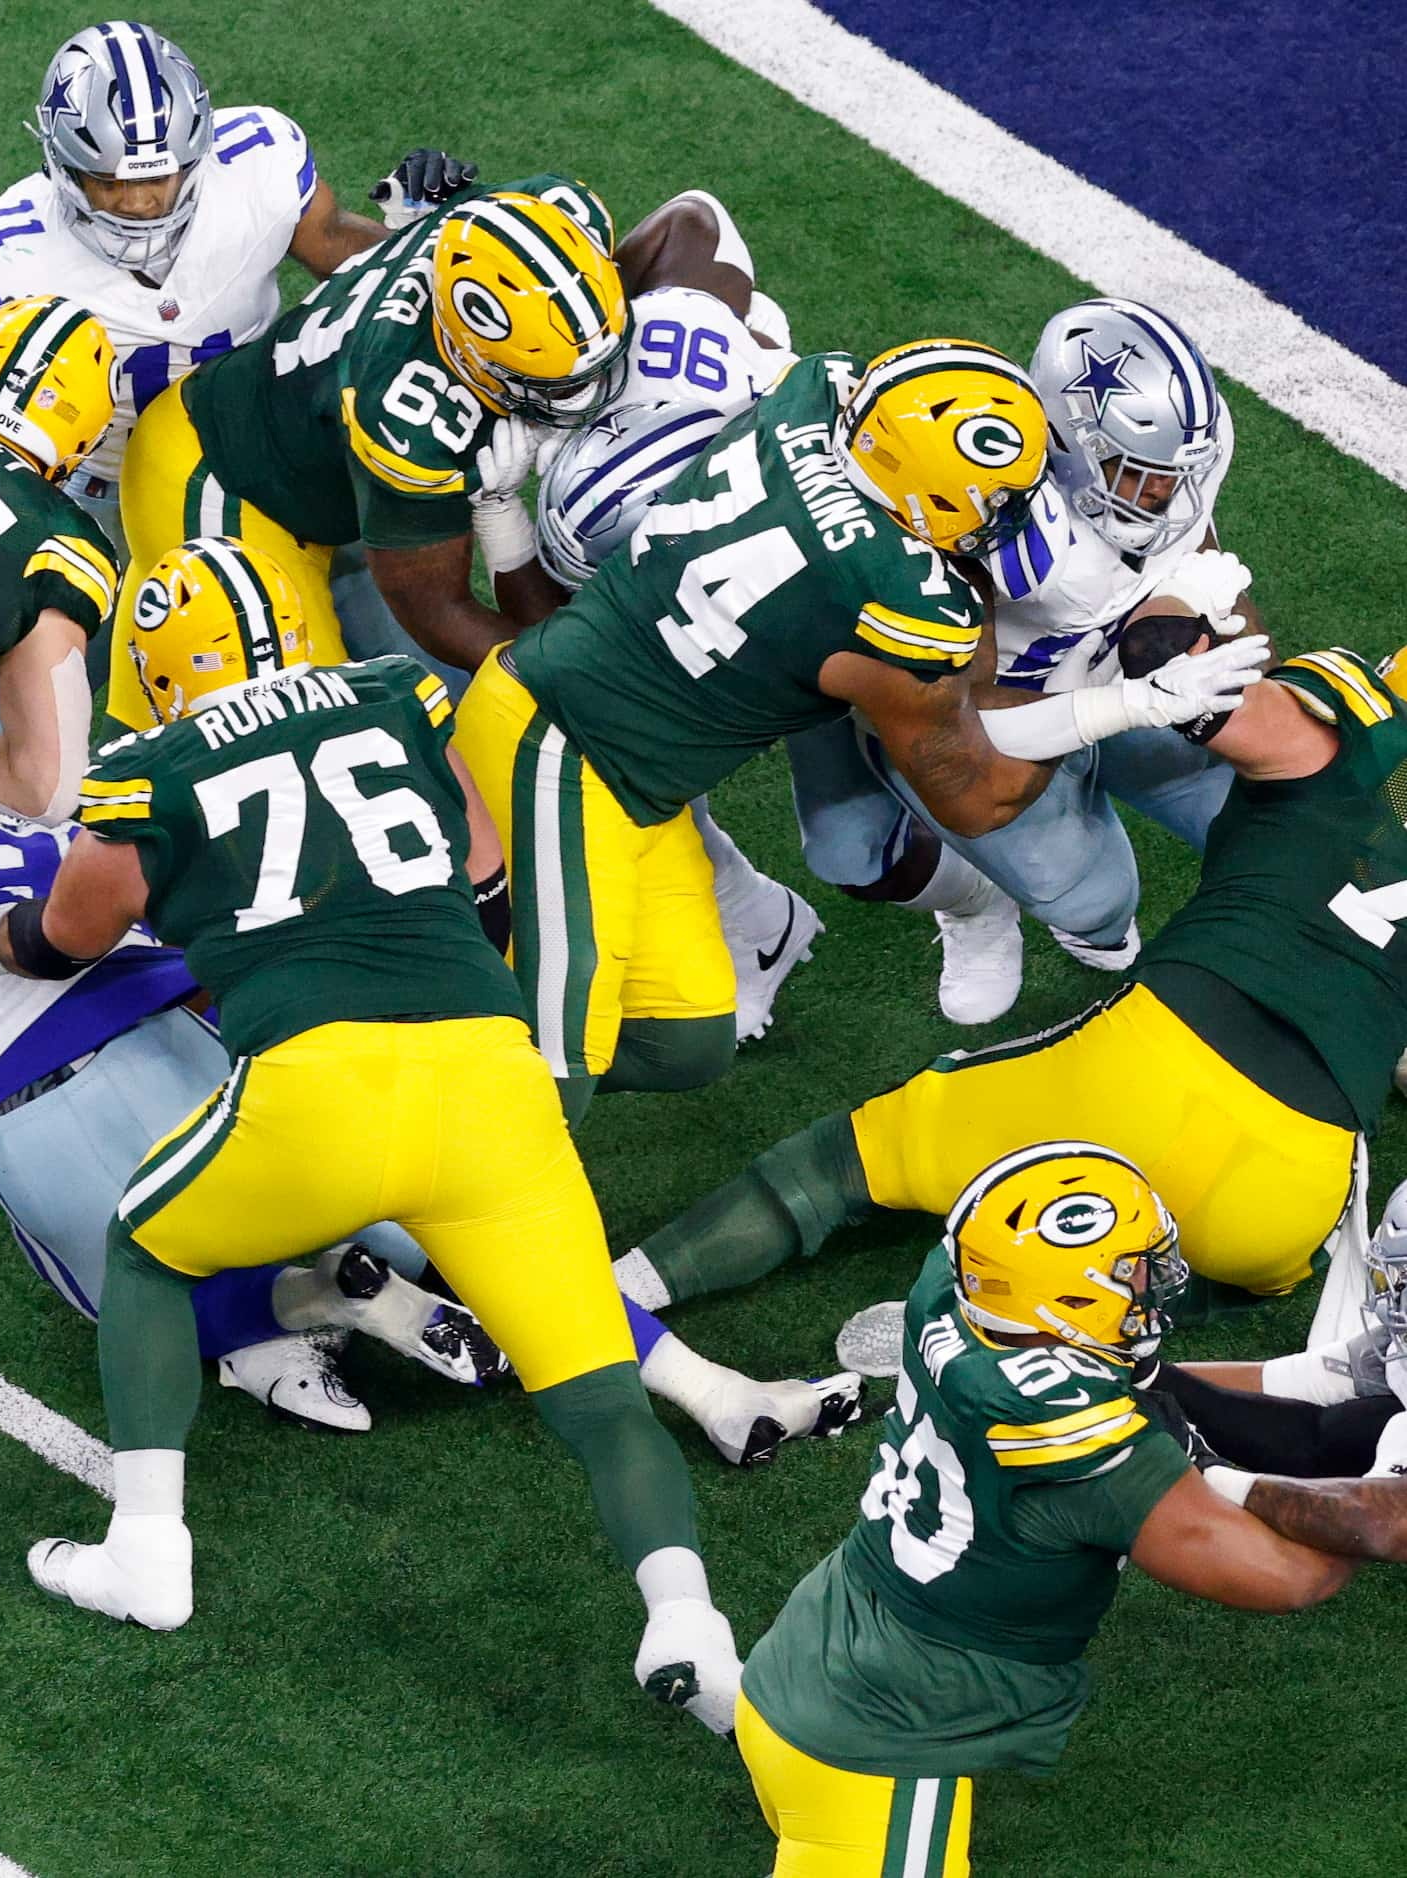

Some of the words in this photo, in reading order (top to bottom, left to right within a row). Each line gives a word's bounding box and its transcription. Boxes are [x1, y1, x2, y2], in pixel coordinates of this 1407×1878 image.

[213, 112, 276, 165] 11
[637, 320, 729, 392] 96
[382, 359, 485, 454] 63
[775, 421, 876, 553] JENKINS
[631, 429, 809, 680] 74
[194, 671, 360, 750] RUNYAN
[243, 687, 260, 699] BE
[262, 675, 292, 693] LOVE
[192, 726, 454, 933] 76
[918, 1313, 968, 1388] TOM
